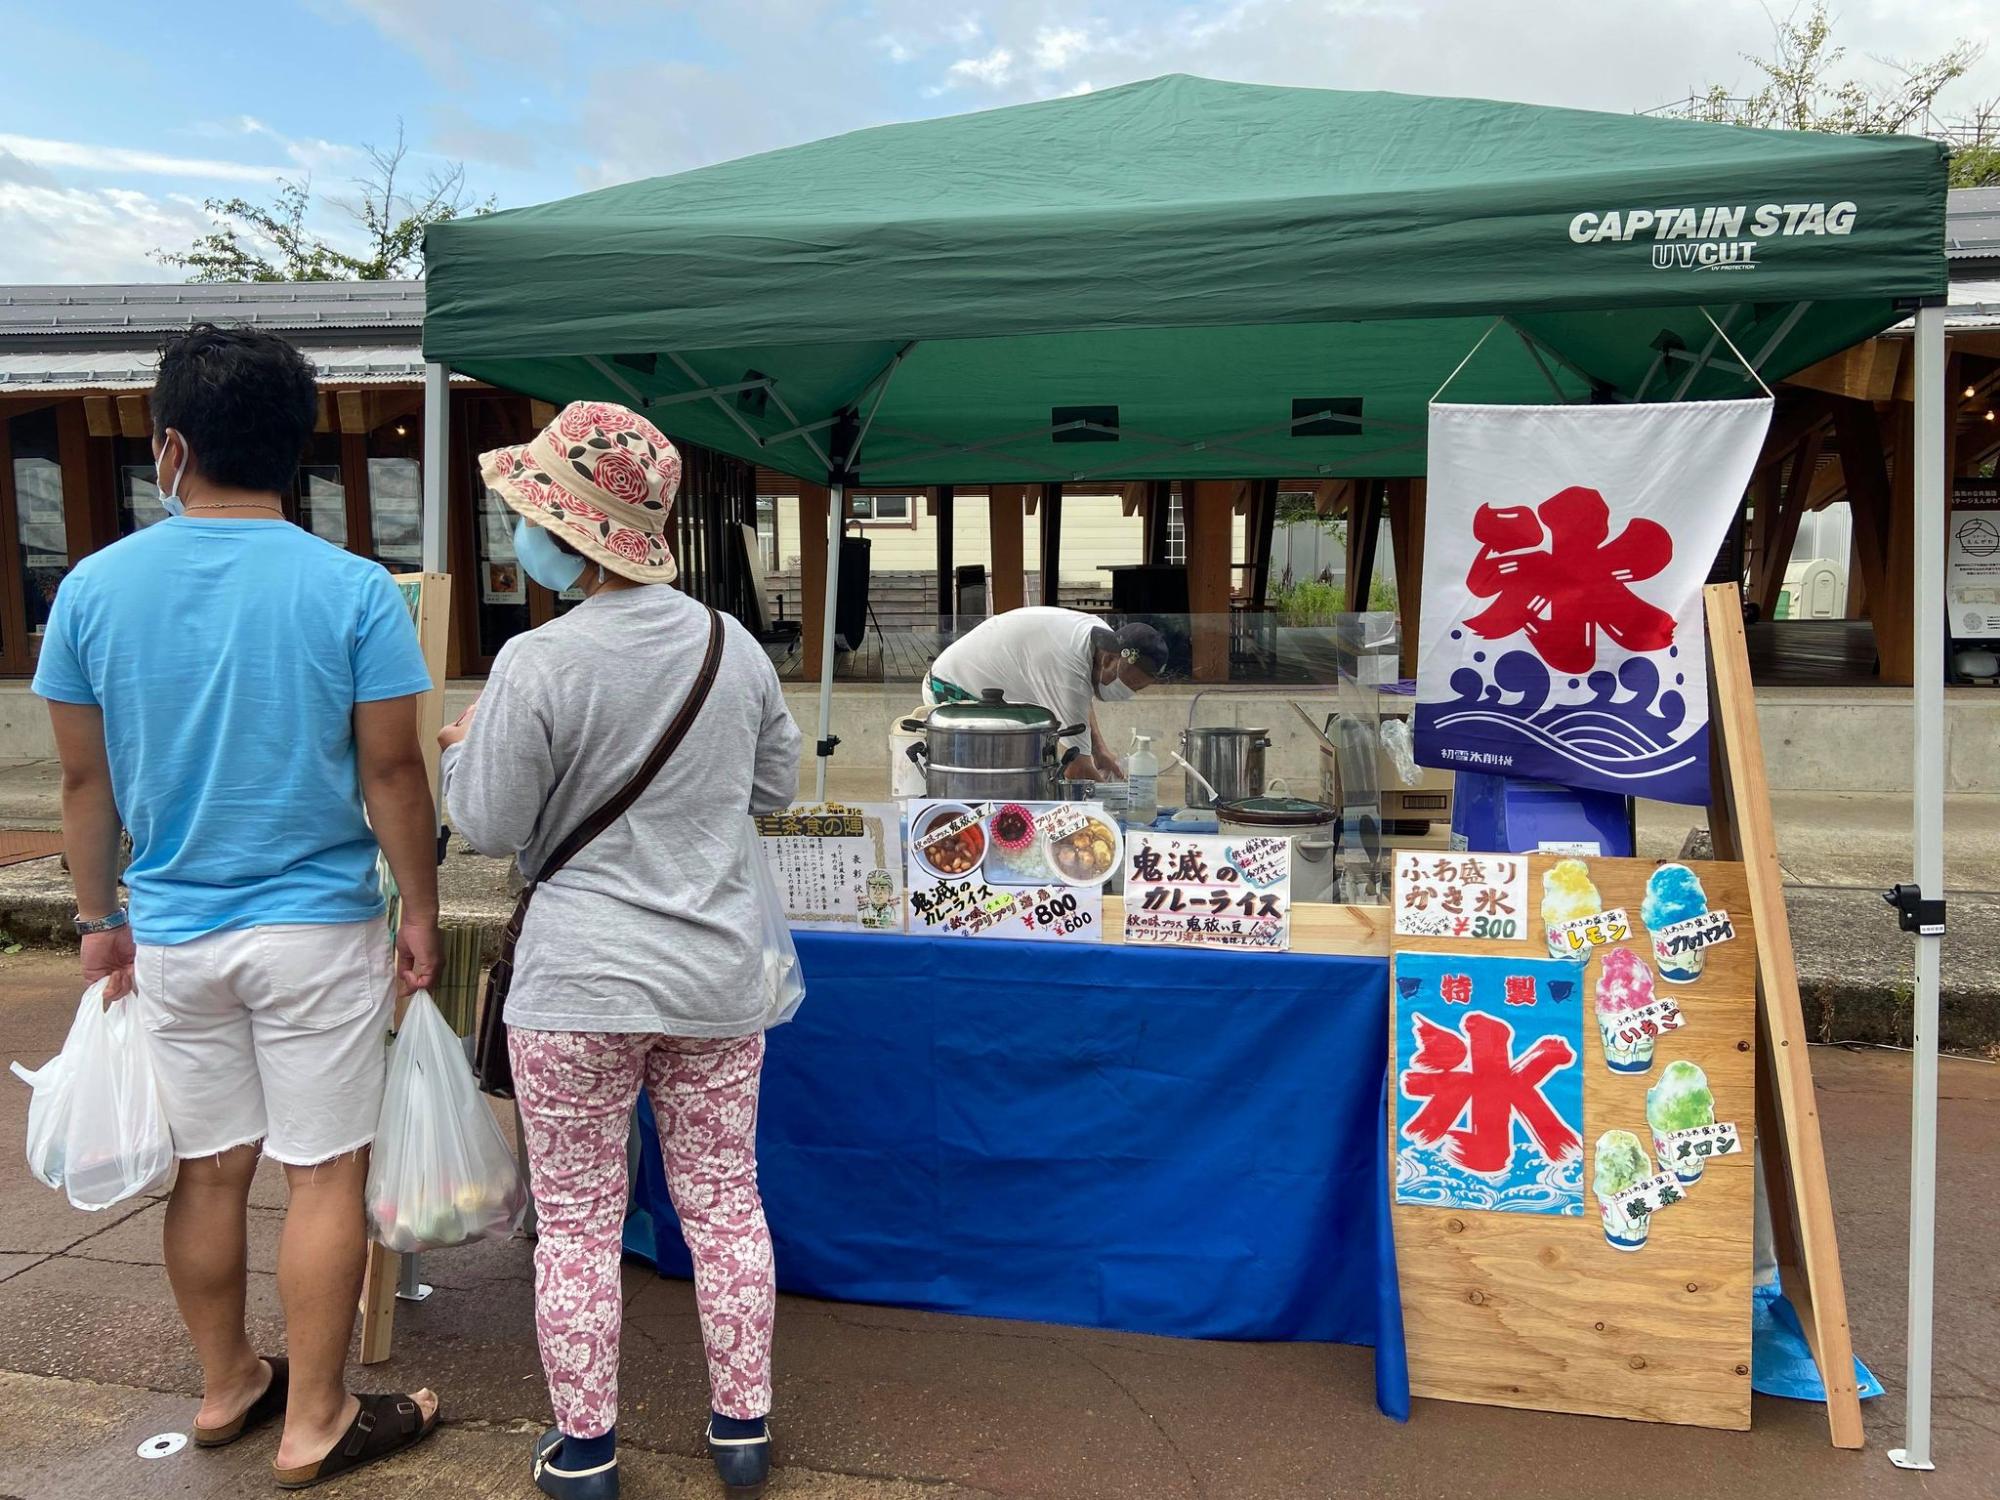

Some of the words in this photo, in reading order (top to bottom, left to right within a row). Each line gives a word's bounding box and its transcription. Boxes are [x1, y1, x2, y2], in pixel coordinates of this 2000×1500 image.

[1569, 205, 1748, 244] CAPTAIN
[1749, 201, 1857, 237] STAG
[1461, 485, 1679, 675] 氷
[1035, 804, 1070, 828] プリプリ
[852, 855, 864, 894] 表彰状
[1131, 846, 1239, 884] 鬼滅の
[1401, 857, 1517, 886] ふわ盛り
[924, 884, 993, 926] カレーライス
[1021, 894, 1077, 931] ¥800
[1141, 886, 1283, 919] カレーライス
[1404, 885, 1516, 916] かき氷
[1052, 911, 1092, 936] ¥600
[1452, 915, 1517, 938] ¥300
[1567, 924, 1627, 950] レモン
[1440, 974, 1539, 1007] 特製
[1620, 1008, 1680, 1043] いちご
[1402, 1011, 1583, 1174] 氷
[1676, 1136, 1736, 1160] メロン
